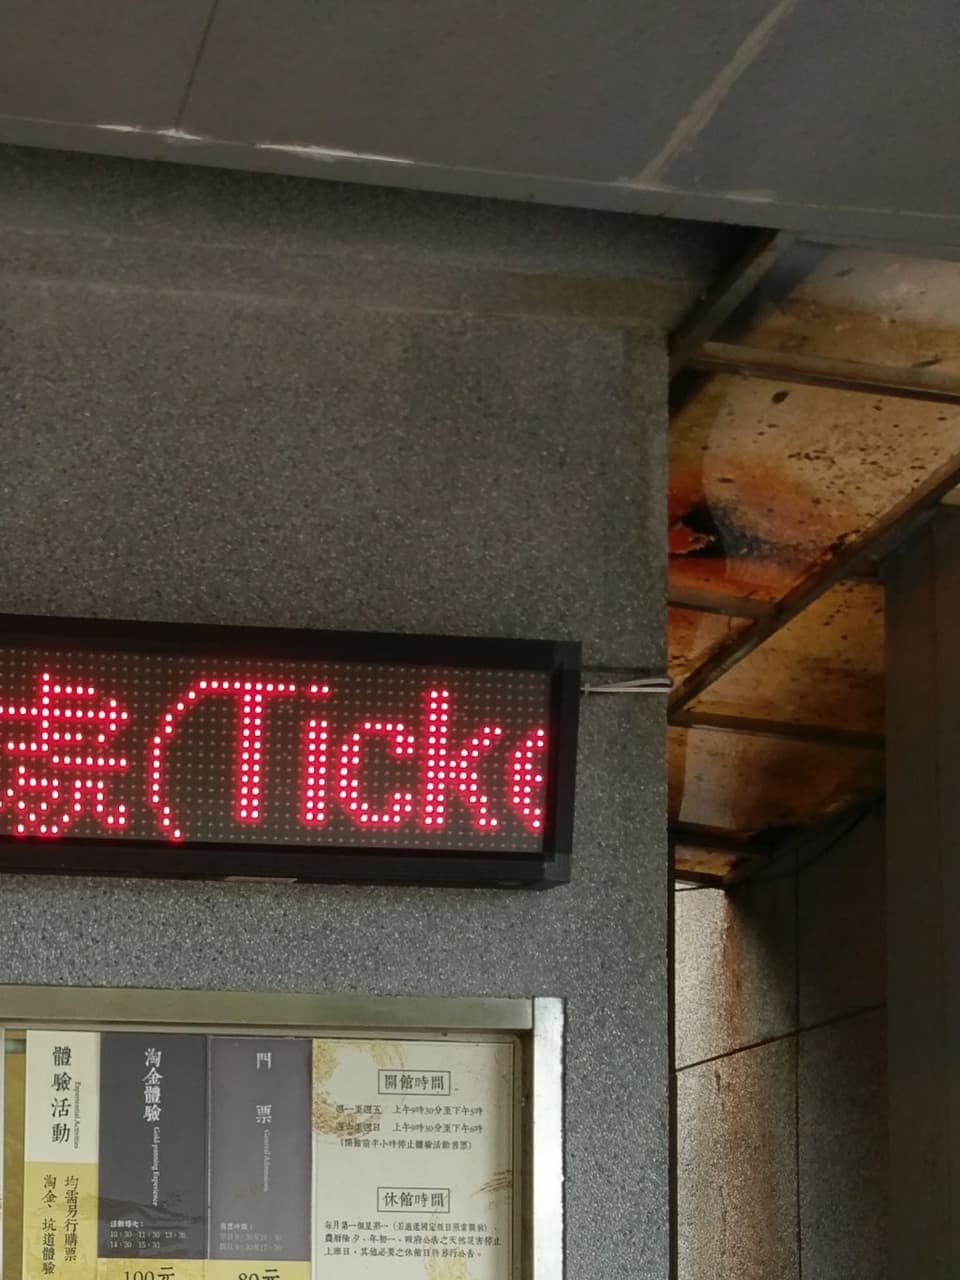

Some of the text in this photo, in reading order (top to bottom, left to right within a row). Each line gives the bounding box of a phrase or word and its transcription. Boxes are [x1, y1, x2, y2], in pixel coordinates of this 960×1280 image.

[50, 1045, 73, 1144] 體驗活動
[142, 1047, 164, 1122] 淘金體驗
[384, 1074, 445, 1091] 開館時間
[41, 1174, 58, 1275] 淘金、坑道體驗
[63, 1175, 80, 1262] 均需另行購票
[384, 1191, 445, 1208] 休館時間
